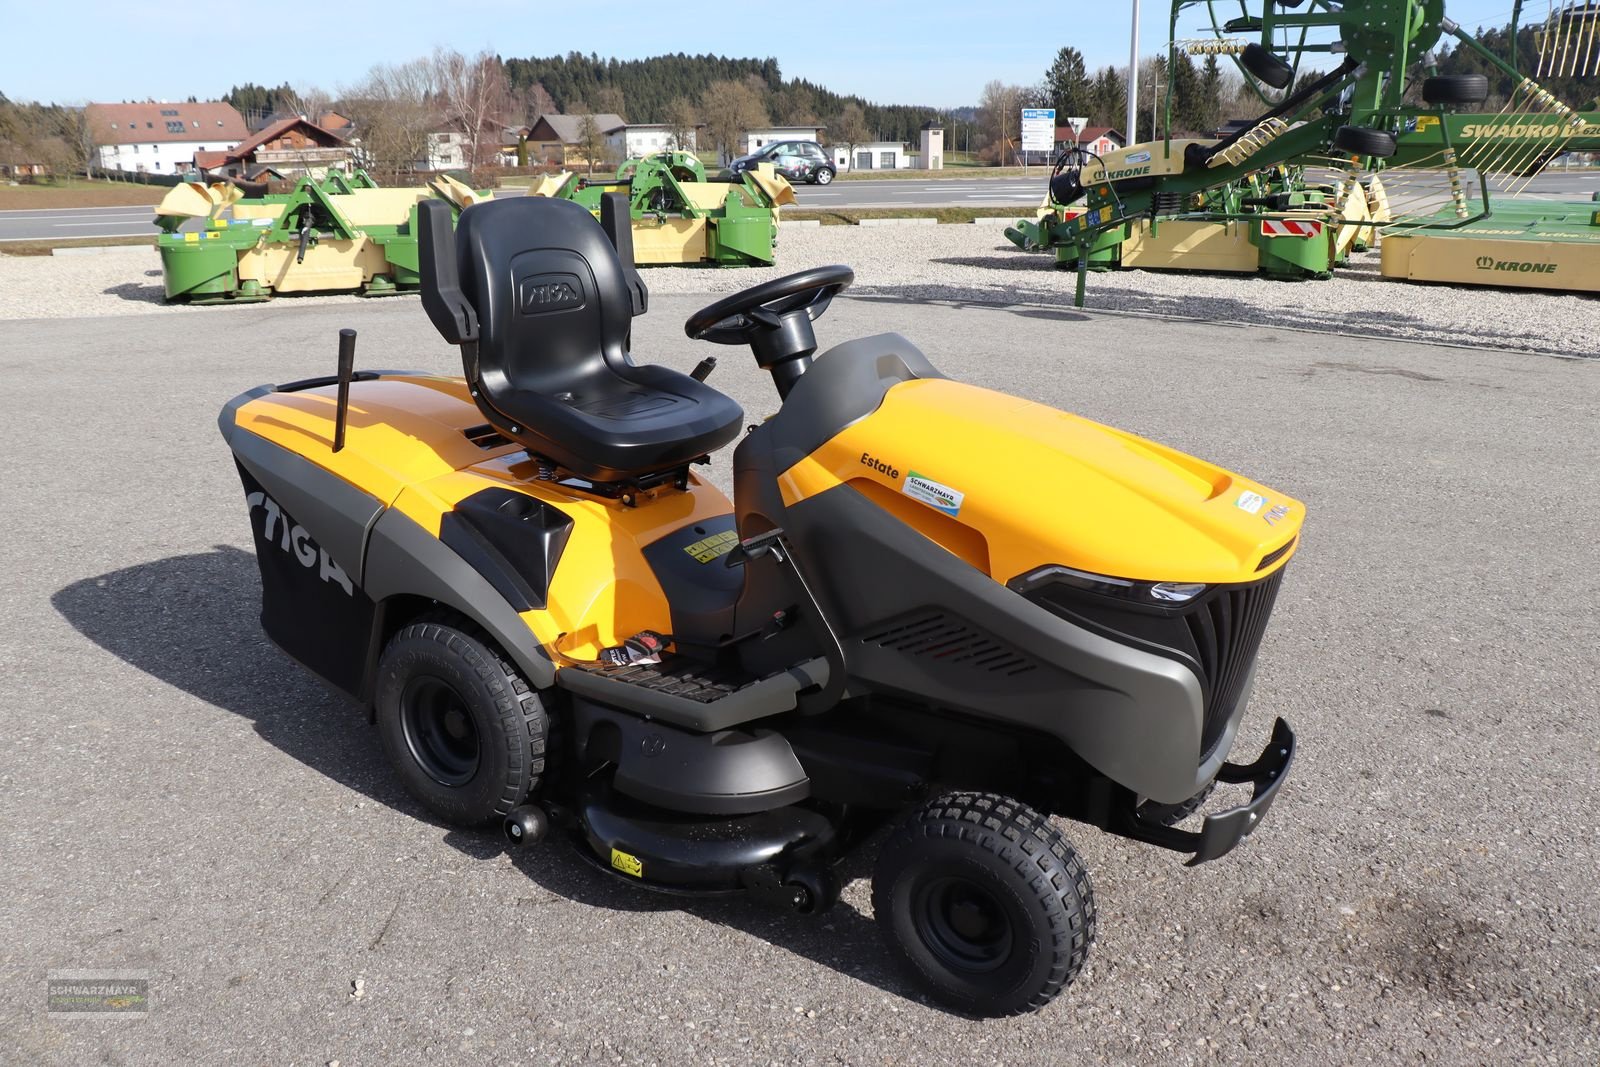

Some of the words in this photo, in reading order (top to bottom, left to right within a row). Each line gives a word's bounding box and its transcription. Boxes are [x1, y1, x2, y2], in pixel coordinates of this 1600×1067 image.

[1460, 124, 1559, 138] SWADRO
[1107, 166, 1151, 179] KRONE
[1494, 261, 1558, 274] KRONE
[860, 452, 899, 479] Estate
[910, 477, 954, 501] SCHWARZMAYR
